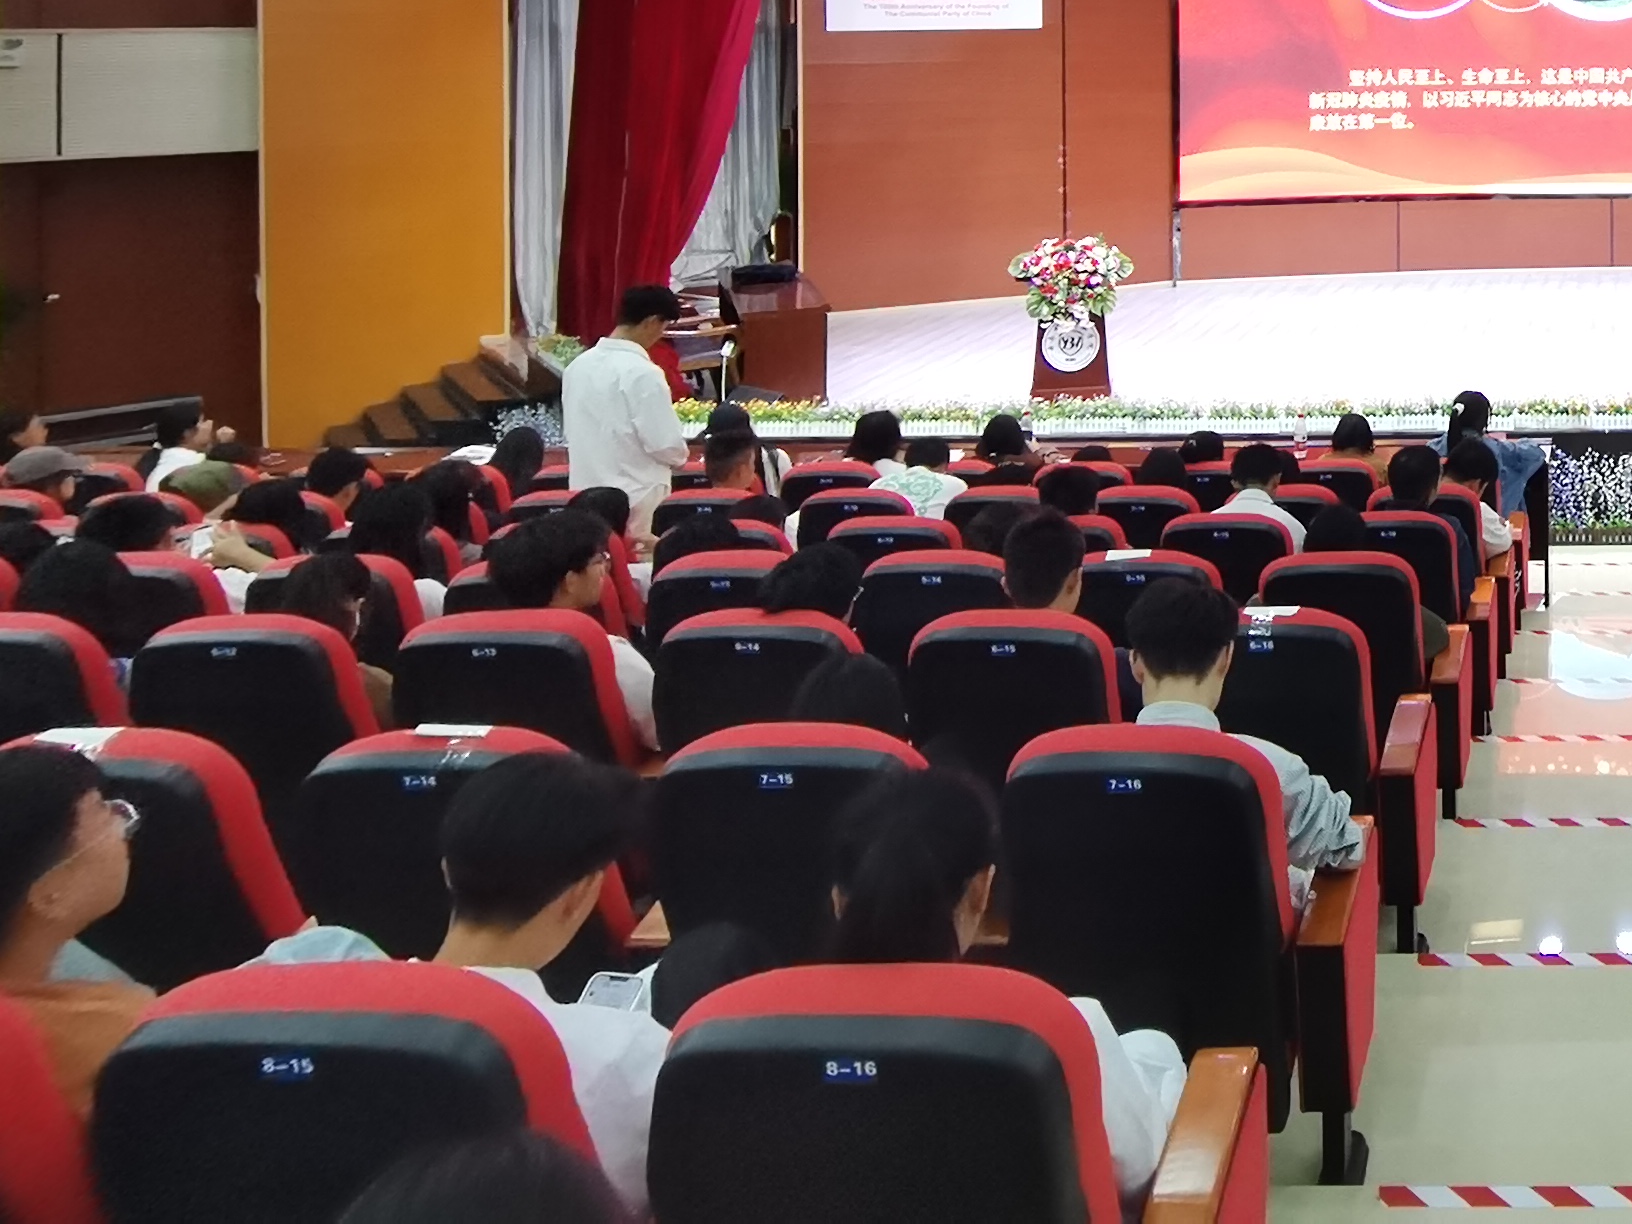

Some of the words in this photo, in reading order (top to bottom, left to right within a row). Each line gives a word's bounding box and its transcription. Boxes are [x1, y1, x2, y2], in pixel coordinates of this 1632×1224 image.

[403, 775, 437, 787] 7-14
[760, 774, 793, 785] 7-15
[1109, 778, 1142, 790] 7-16
[261, 1057, 314, 1074] 8-15
[825, 1060, 877, 1076] 8-16
